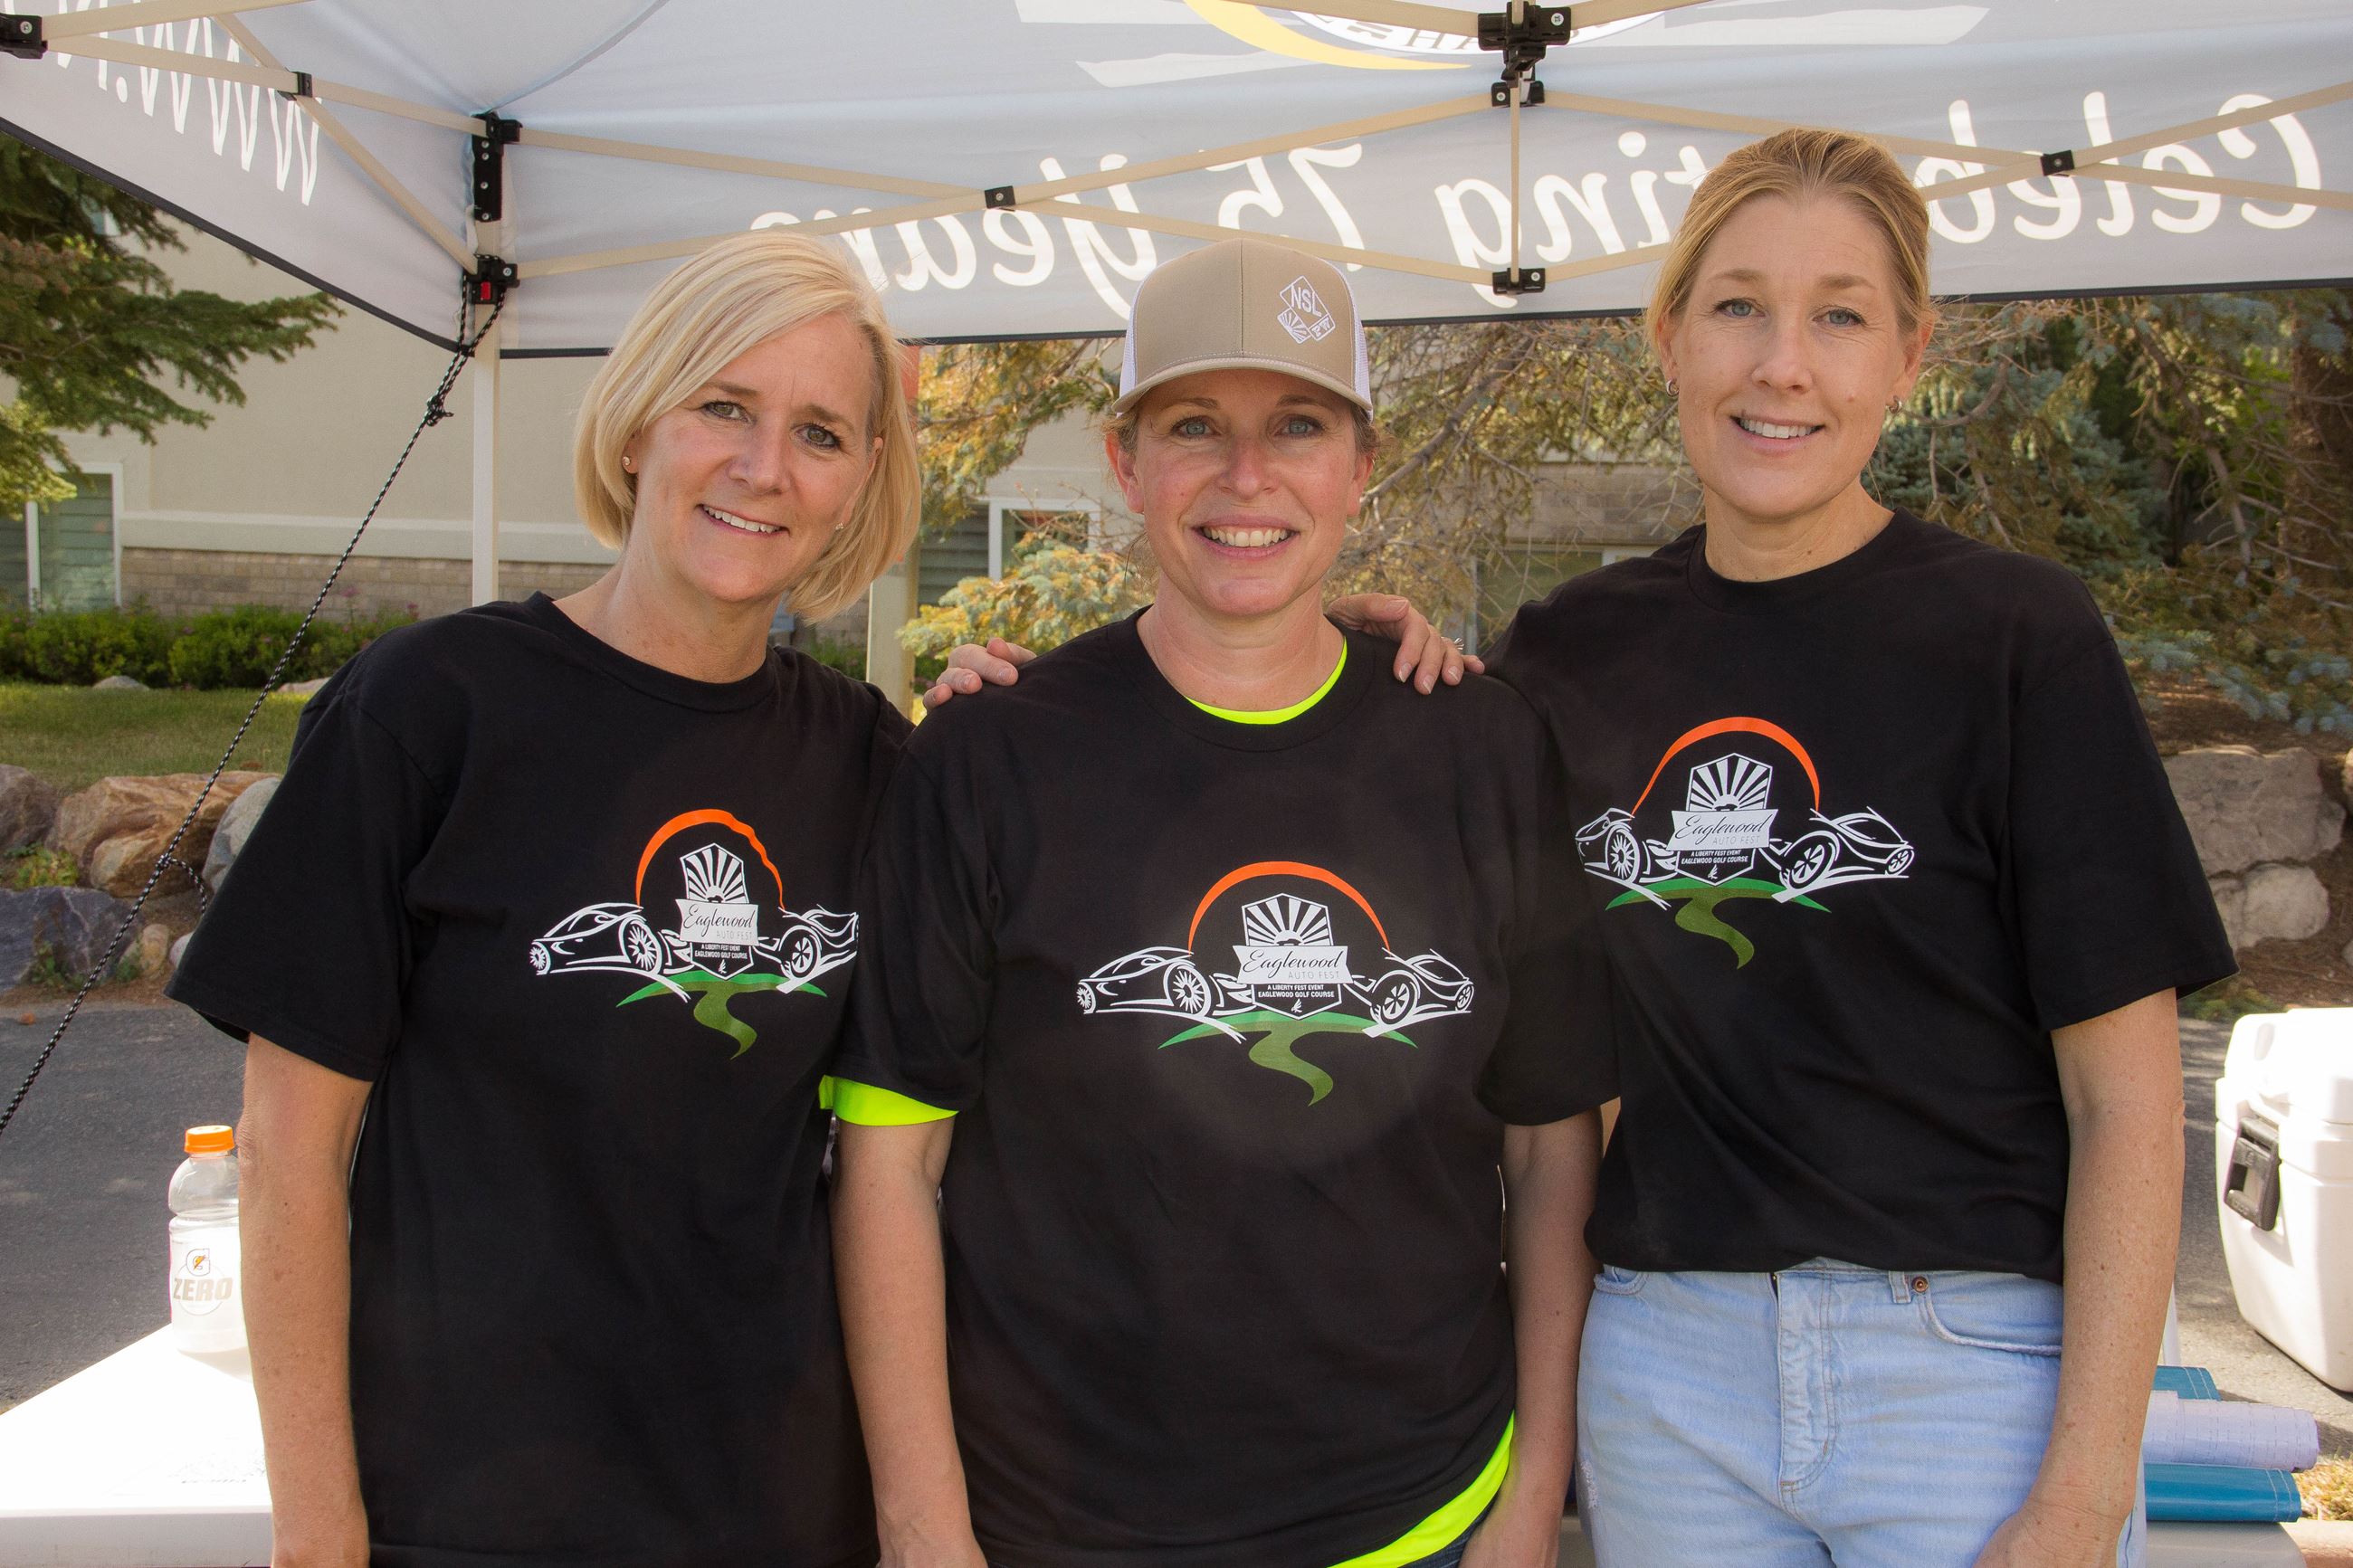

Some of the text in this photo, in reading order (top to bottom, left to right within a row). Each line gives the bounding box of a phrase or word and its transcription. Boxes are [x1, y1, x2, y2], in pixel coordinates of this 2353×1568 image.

[1291, 284, 1321, 317] NSL
[1675, 813, 1773, 845] Eaglewood
[1713, 835, 1760, 845] AUTO FEST
[683, 904, 756, 937] Eaglewood
[717, 930, 752, 940] AUTO FEST
[694, 950, 720, 958] EAGLEWOOD
[1243, 949, 1344, 978] Eaglewood
[1289, 971, 1339, 979] AUTO FEST
[173, 1278, 233, 1301] ZERO
